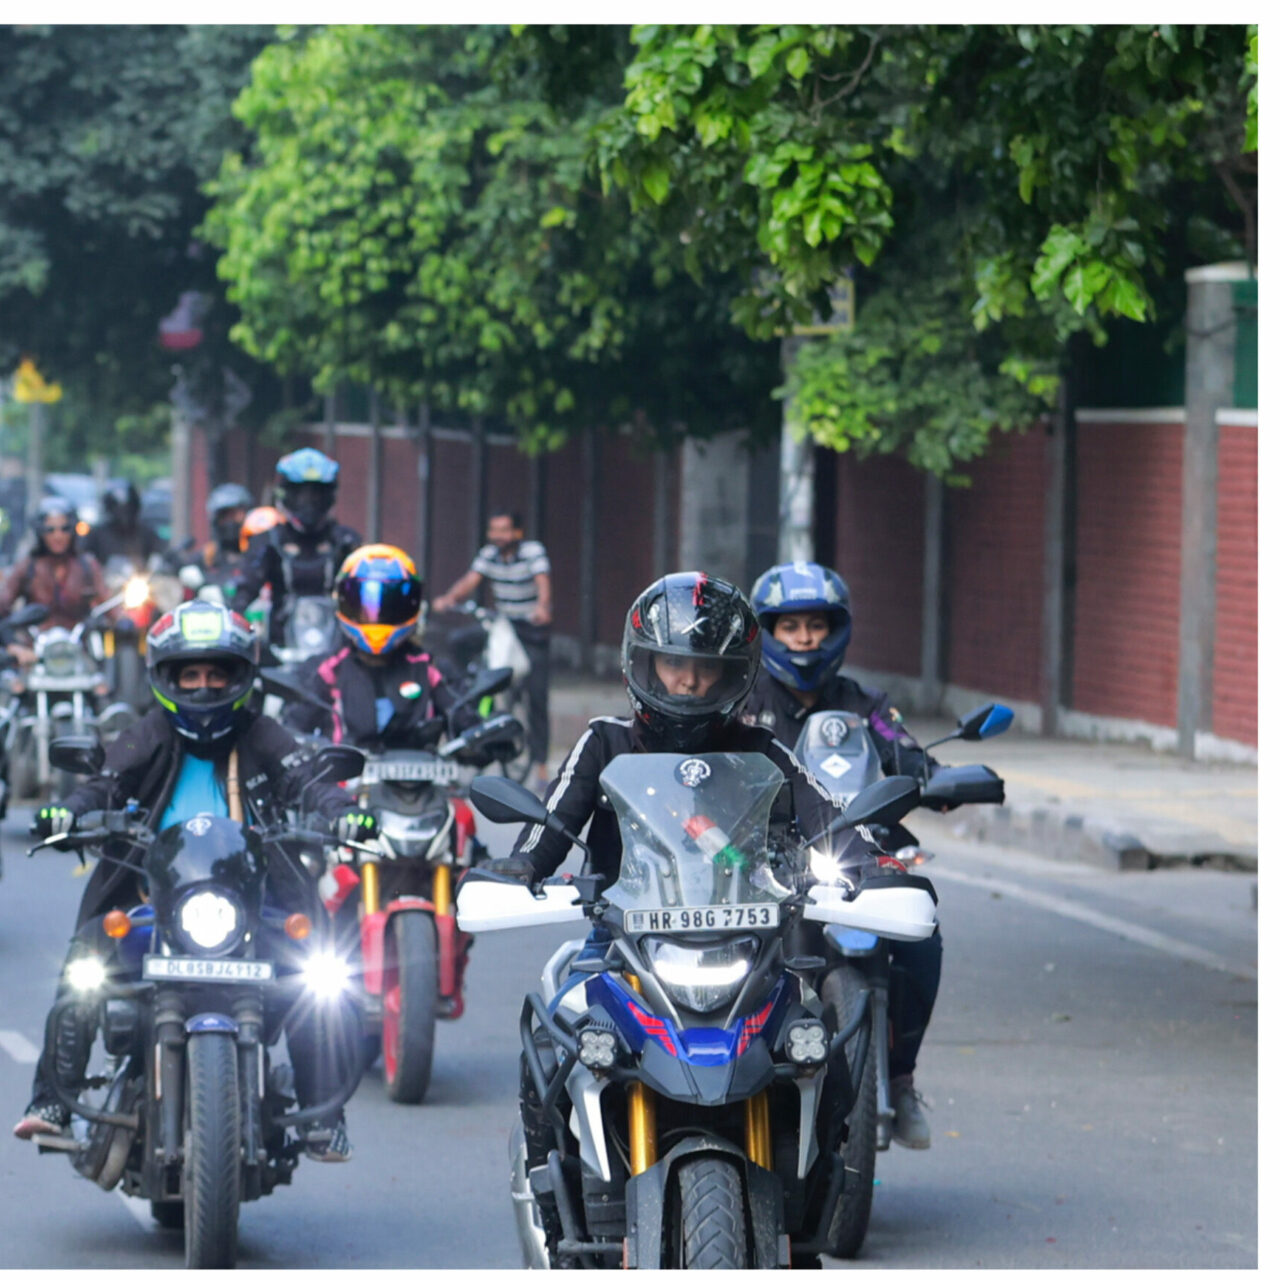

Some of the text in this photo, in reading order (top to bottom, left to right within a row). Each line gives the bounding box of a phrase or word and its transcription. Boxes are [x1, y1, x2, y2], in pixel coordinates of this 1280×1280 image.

[649, 912, 671, 930] HR
[680, 910, 715, 928] 98G
[723, 907, 770, 926] 7753
